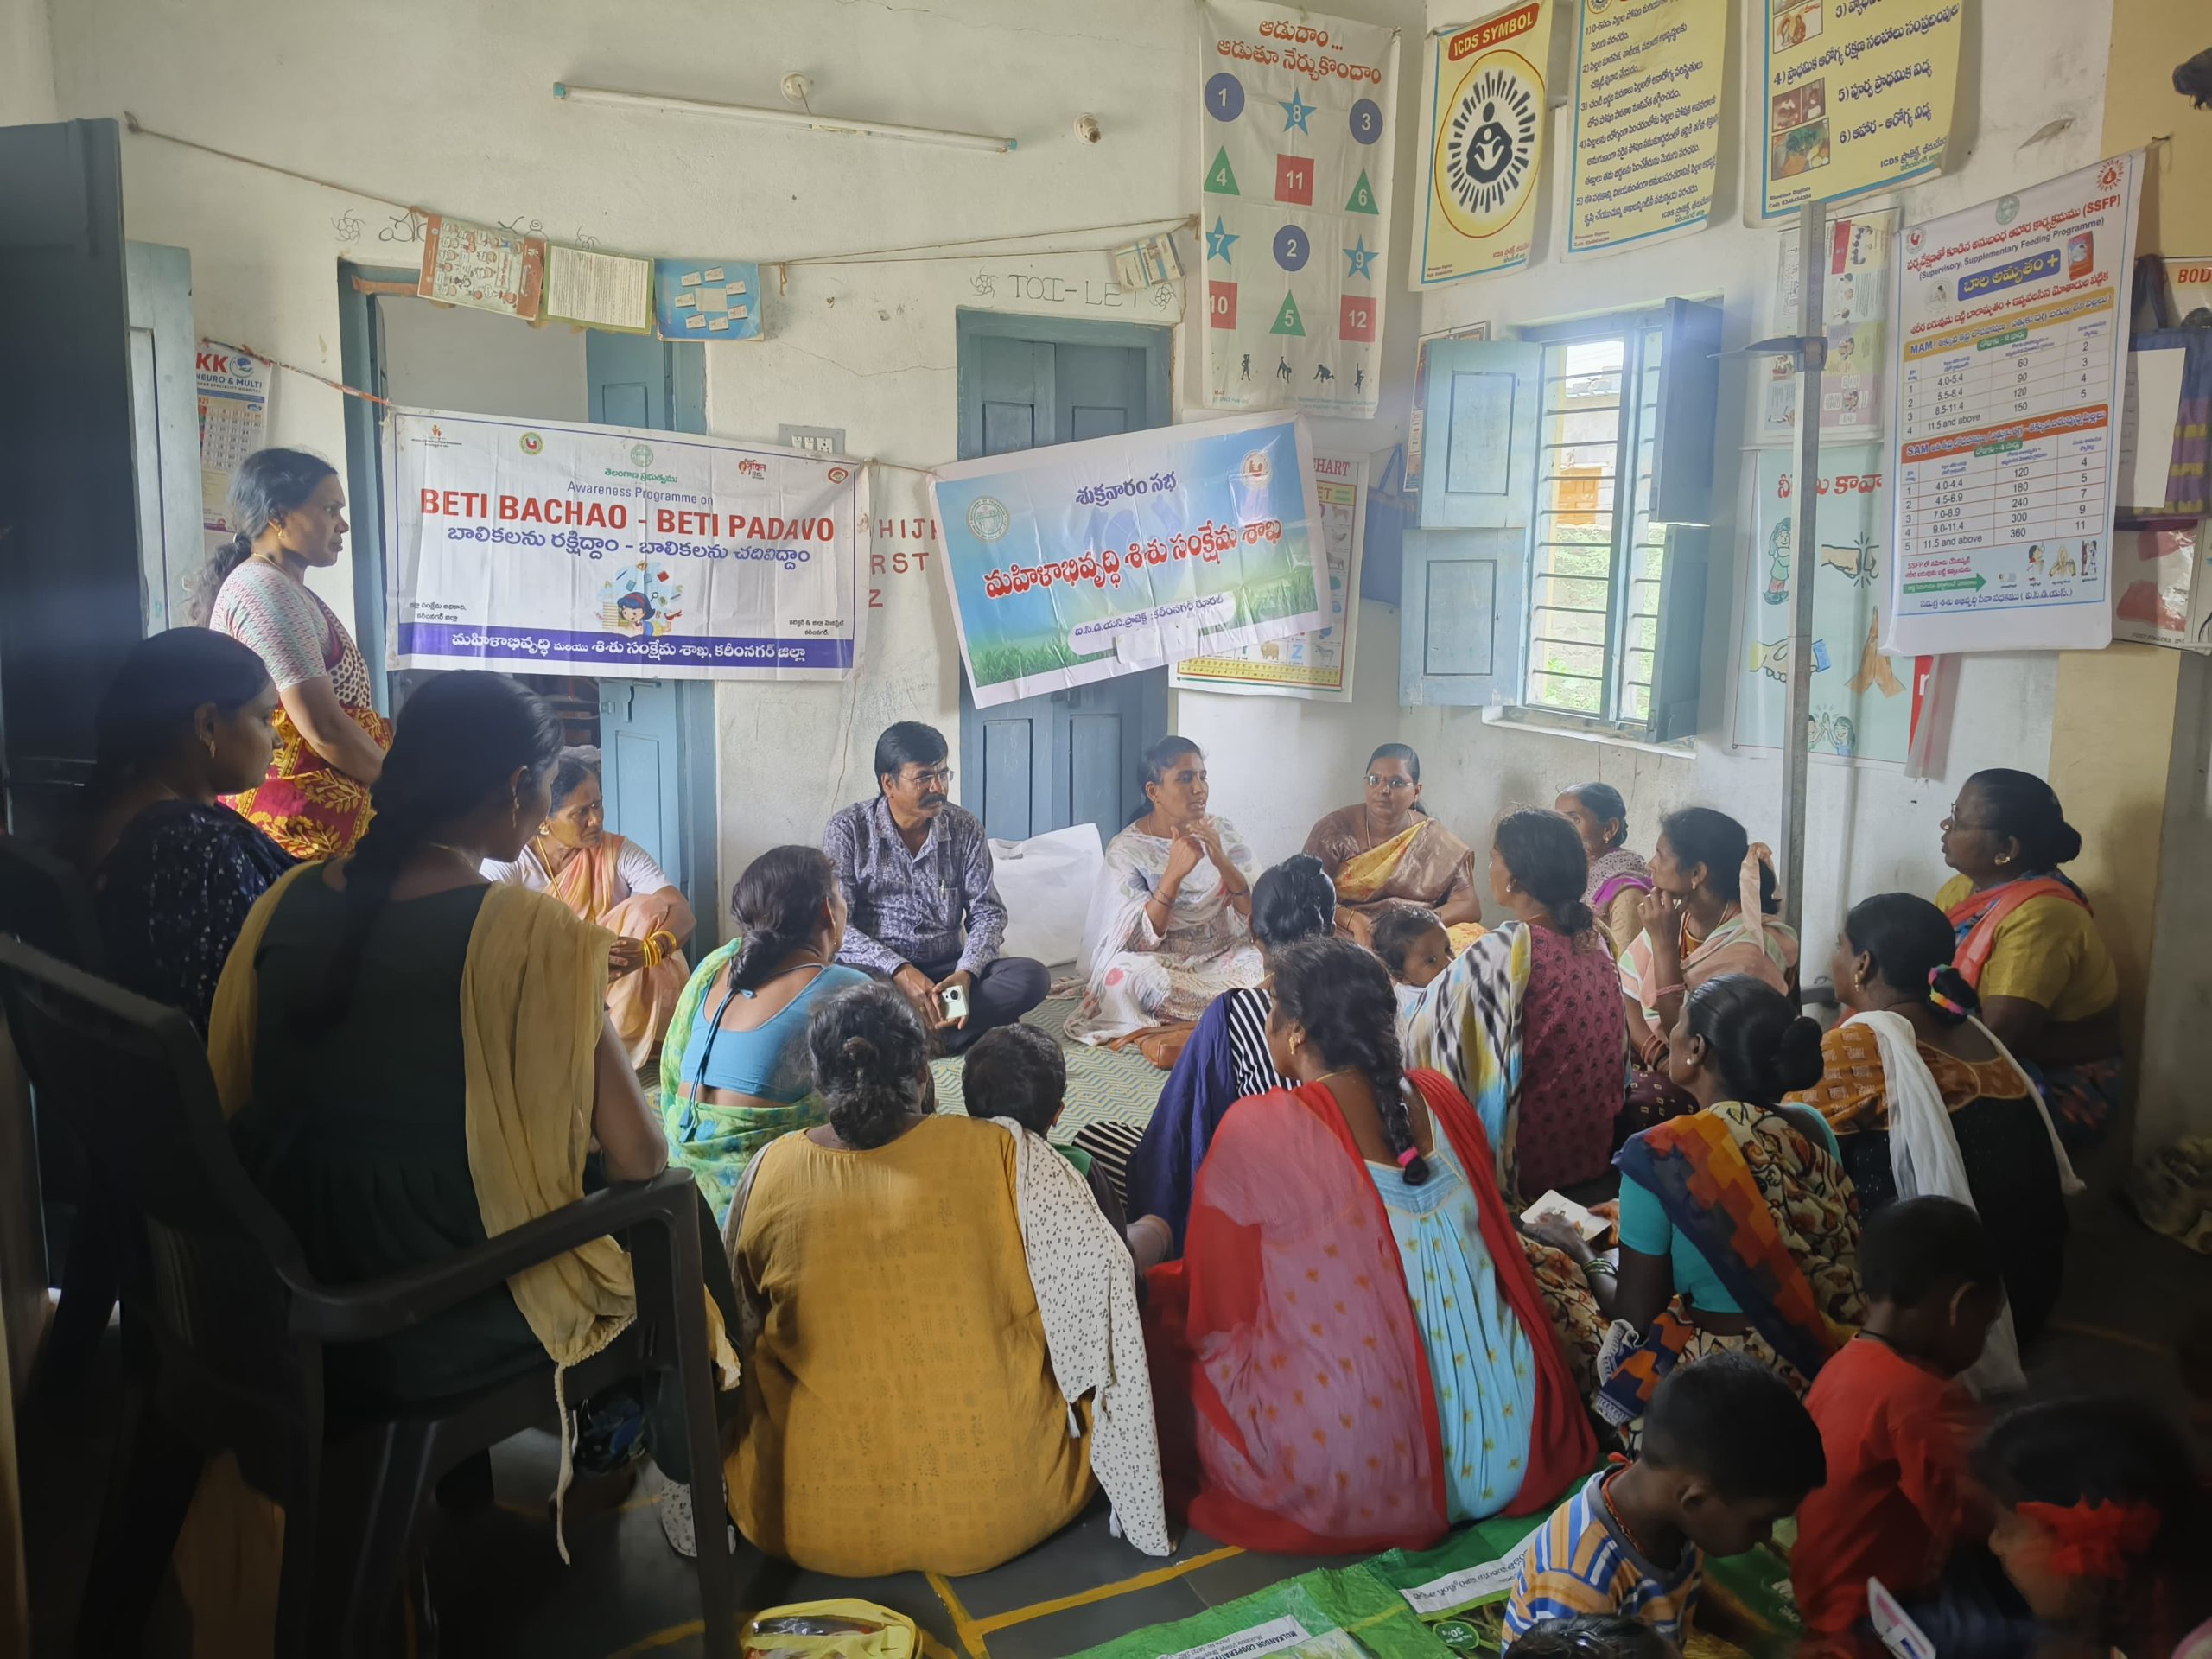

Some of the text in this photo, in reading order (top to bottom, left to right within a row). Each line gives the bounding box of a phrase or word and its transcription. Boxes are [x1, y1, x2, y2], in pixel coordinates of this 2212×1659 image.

[1835, 3, 1847, 18] 3)
[1259, 20, 1329, 47] ఆడుదాం
[1454, 11, 1533, 57] ICDS SYMBOL
[1217, 40, 1382, 84] ఆడుతూ నేర్చుకొందాం
[1774, 71, 1785, 85] 4)
[1838, 86, 1849, 102] 5)
[1914, 59, 1932, 78] విద్య
[1219, 88, 1228, 107] 1
[1292, 105, 1302, 123] 8
[1361, 113, 1371, 131] 3
[1840, 129, 1851, 143] 6)
[1885, 108, 1913, 128] ఆరోగ్య
[1915, 102, 1931, 121] విద్య
[1880, 156, 1898, 168] ICDS
[1216, 168, 1227, 186] 4
[1287, 170, 1304, 189] 11
[1358, 189, 1368, 207] 6
[2082, 194, 2121, 217] (SSFP)
[1214, 234, 1224, 252] 7
[1287, 239, 1297, 257] 2
[1964, 243, 2019, 265] Supplementary
[2020, 232, 2050, 248] Feeding
[2053, 217, 2104, 238] Programme)
[1356, 251, 1364, 269] 9
[1210, 296, 1228, 315] 10
[1285, 309, 1294, 327] 5
[1348, 310, 1367, 328] 12
[1910, 342, 1933, 354] MAM
[196, 352, 229, 373] KK
[1937, 374, 1964, 386] 4.0-5.4
[2018, 358, 2029, 368] 60
[2082, 342, 2088, 351] 2
[196, 373, 226, 383] NEURO
[237, 378, 262, 388] MULTI
[1908, 358, 2088, 408] 2 5.5-8.4 90 3
[1908, 373, 2087, 421] 3 8.5-11.4 120 4
[1907, 390, 2086, 435] 4 11.5 and above 150 5
[1907, 445, 1929, 456] SAM
[605, 467, 639, 480] తెలంగాణ
[1936, 479, 1963, 491] 4.0-4.4
[2015, 467, 2029, 478] 120
[2081, 458, 2088, 467] 4
[567, 480, 713, 505] Awareness Programme on
[1076, 470, 1178, 507] శుక్రవారం సభ
[1906, 474, 2087, 509] 2 4.5-6.9 180 5
[421, 488, 834, 542] BETI BACHAO BETI PADAVO
[1905, 489, 2087, 523] 3 7.0-8.9 240 7
[1905, 505, 2086, 537] 4 9.0-11.4 300 9
[1905, 520, 2086, 551] 5 11.5 and above 360 11
[448, 526, 810, 570] బాలికలను రక్షిద్దాం బాలికలను చదివిద్దాం
[983, 518, 1282, 599] మహిళాభివృద్ధి శిశు సంక్షేమ శాఖ
[868, 589, 883, 607] Z
[1195, 594, 1224, 609] రూరల్
[452, 632, 805, 662] మహిళాభివృద్ధి మరియు శిశు సంక్షేమ శాఖ, కరీంనగర్ జిల్లా
[1451, 1627, 1464, 1637] 30
